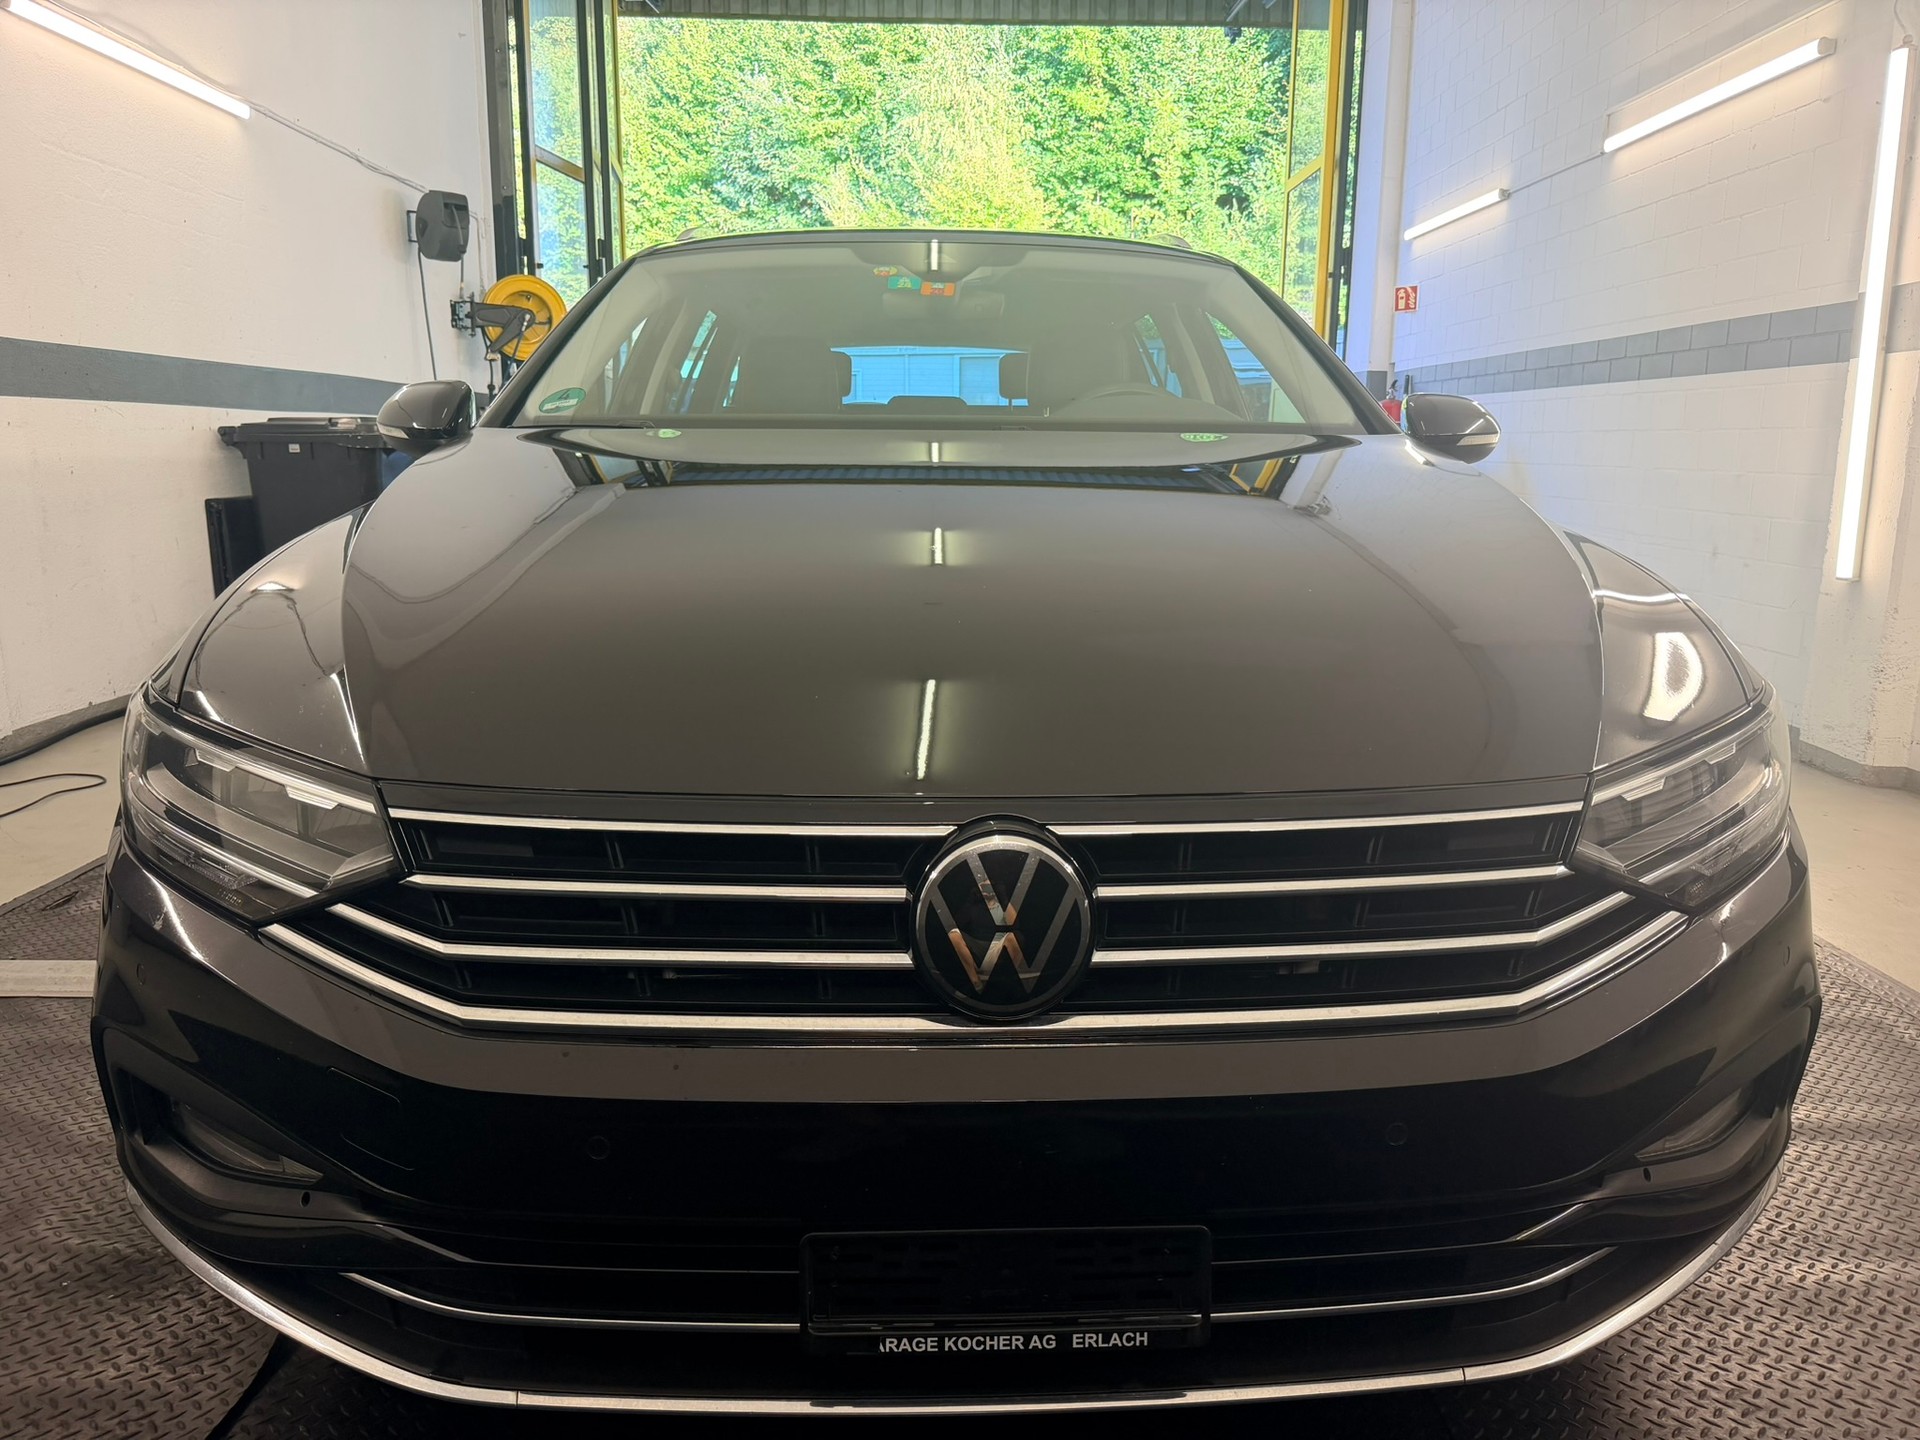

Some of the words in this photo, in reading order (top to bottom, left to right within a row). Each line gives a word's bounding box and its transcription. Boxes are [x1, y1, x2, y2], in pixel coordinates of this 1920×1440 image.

[944, 1335, 1025, 1351] KOCHER
[1028, 1334, 1056, 1350] AG
[1072, 1331, 1149, 1348] ERLACH
